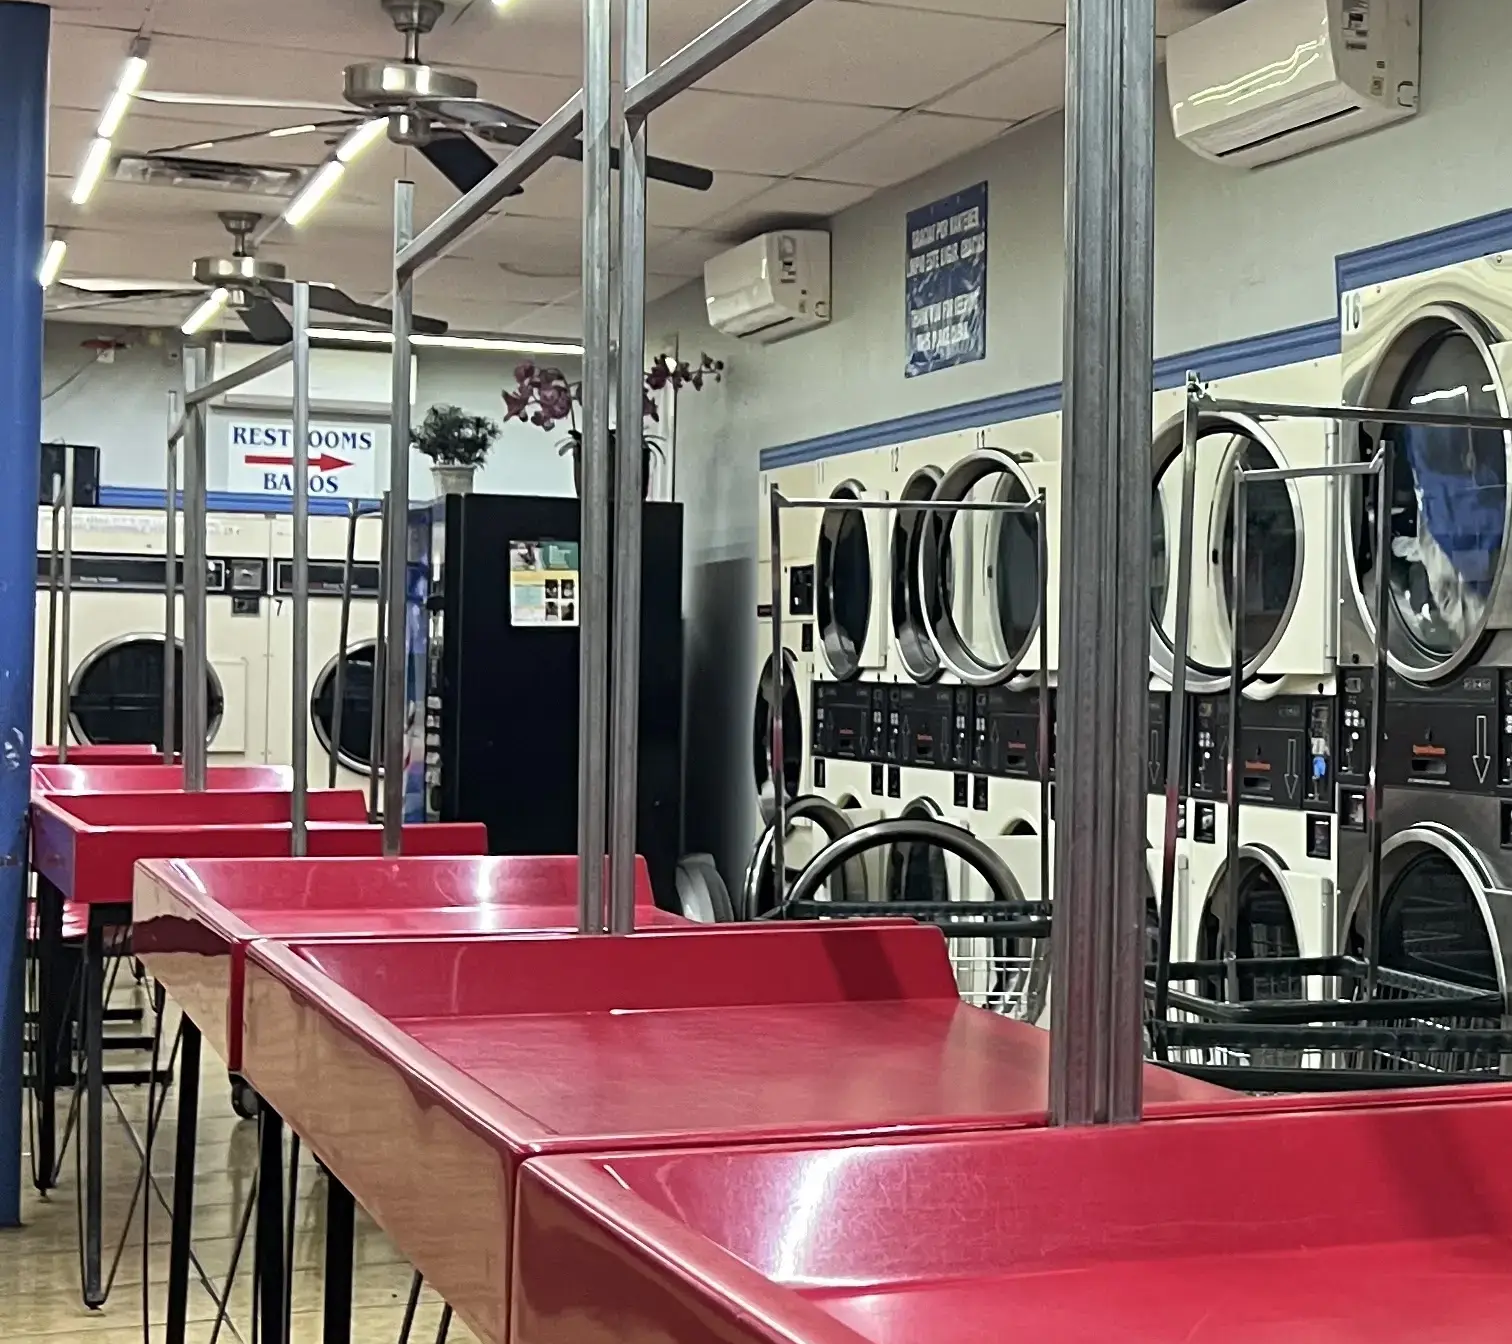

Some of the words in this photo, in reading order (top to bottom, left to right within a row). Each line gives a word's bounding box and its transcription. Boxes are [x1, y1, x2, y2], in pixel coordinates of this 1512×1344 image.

[1345, 292, 1360, 331] 16
[233, 426, 372, 450] RESTOOMS
[263, 473, 339, 493] BAOS
[275, 599, 283, 617] 7
